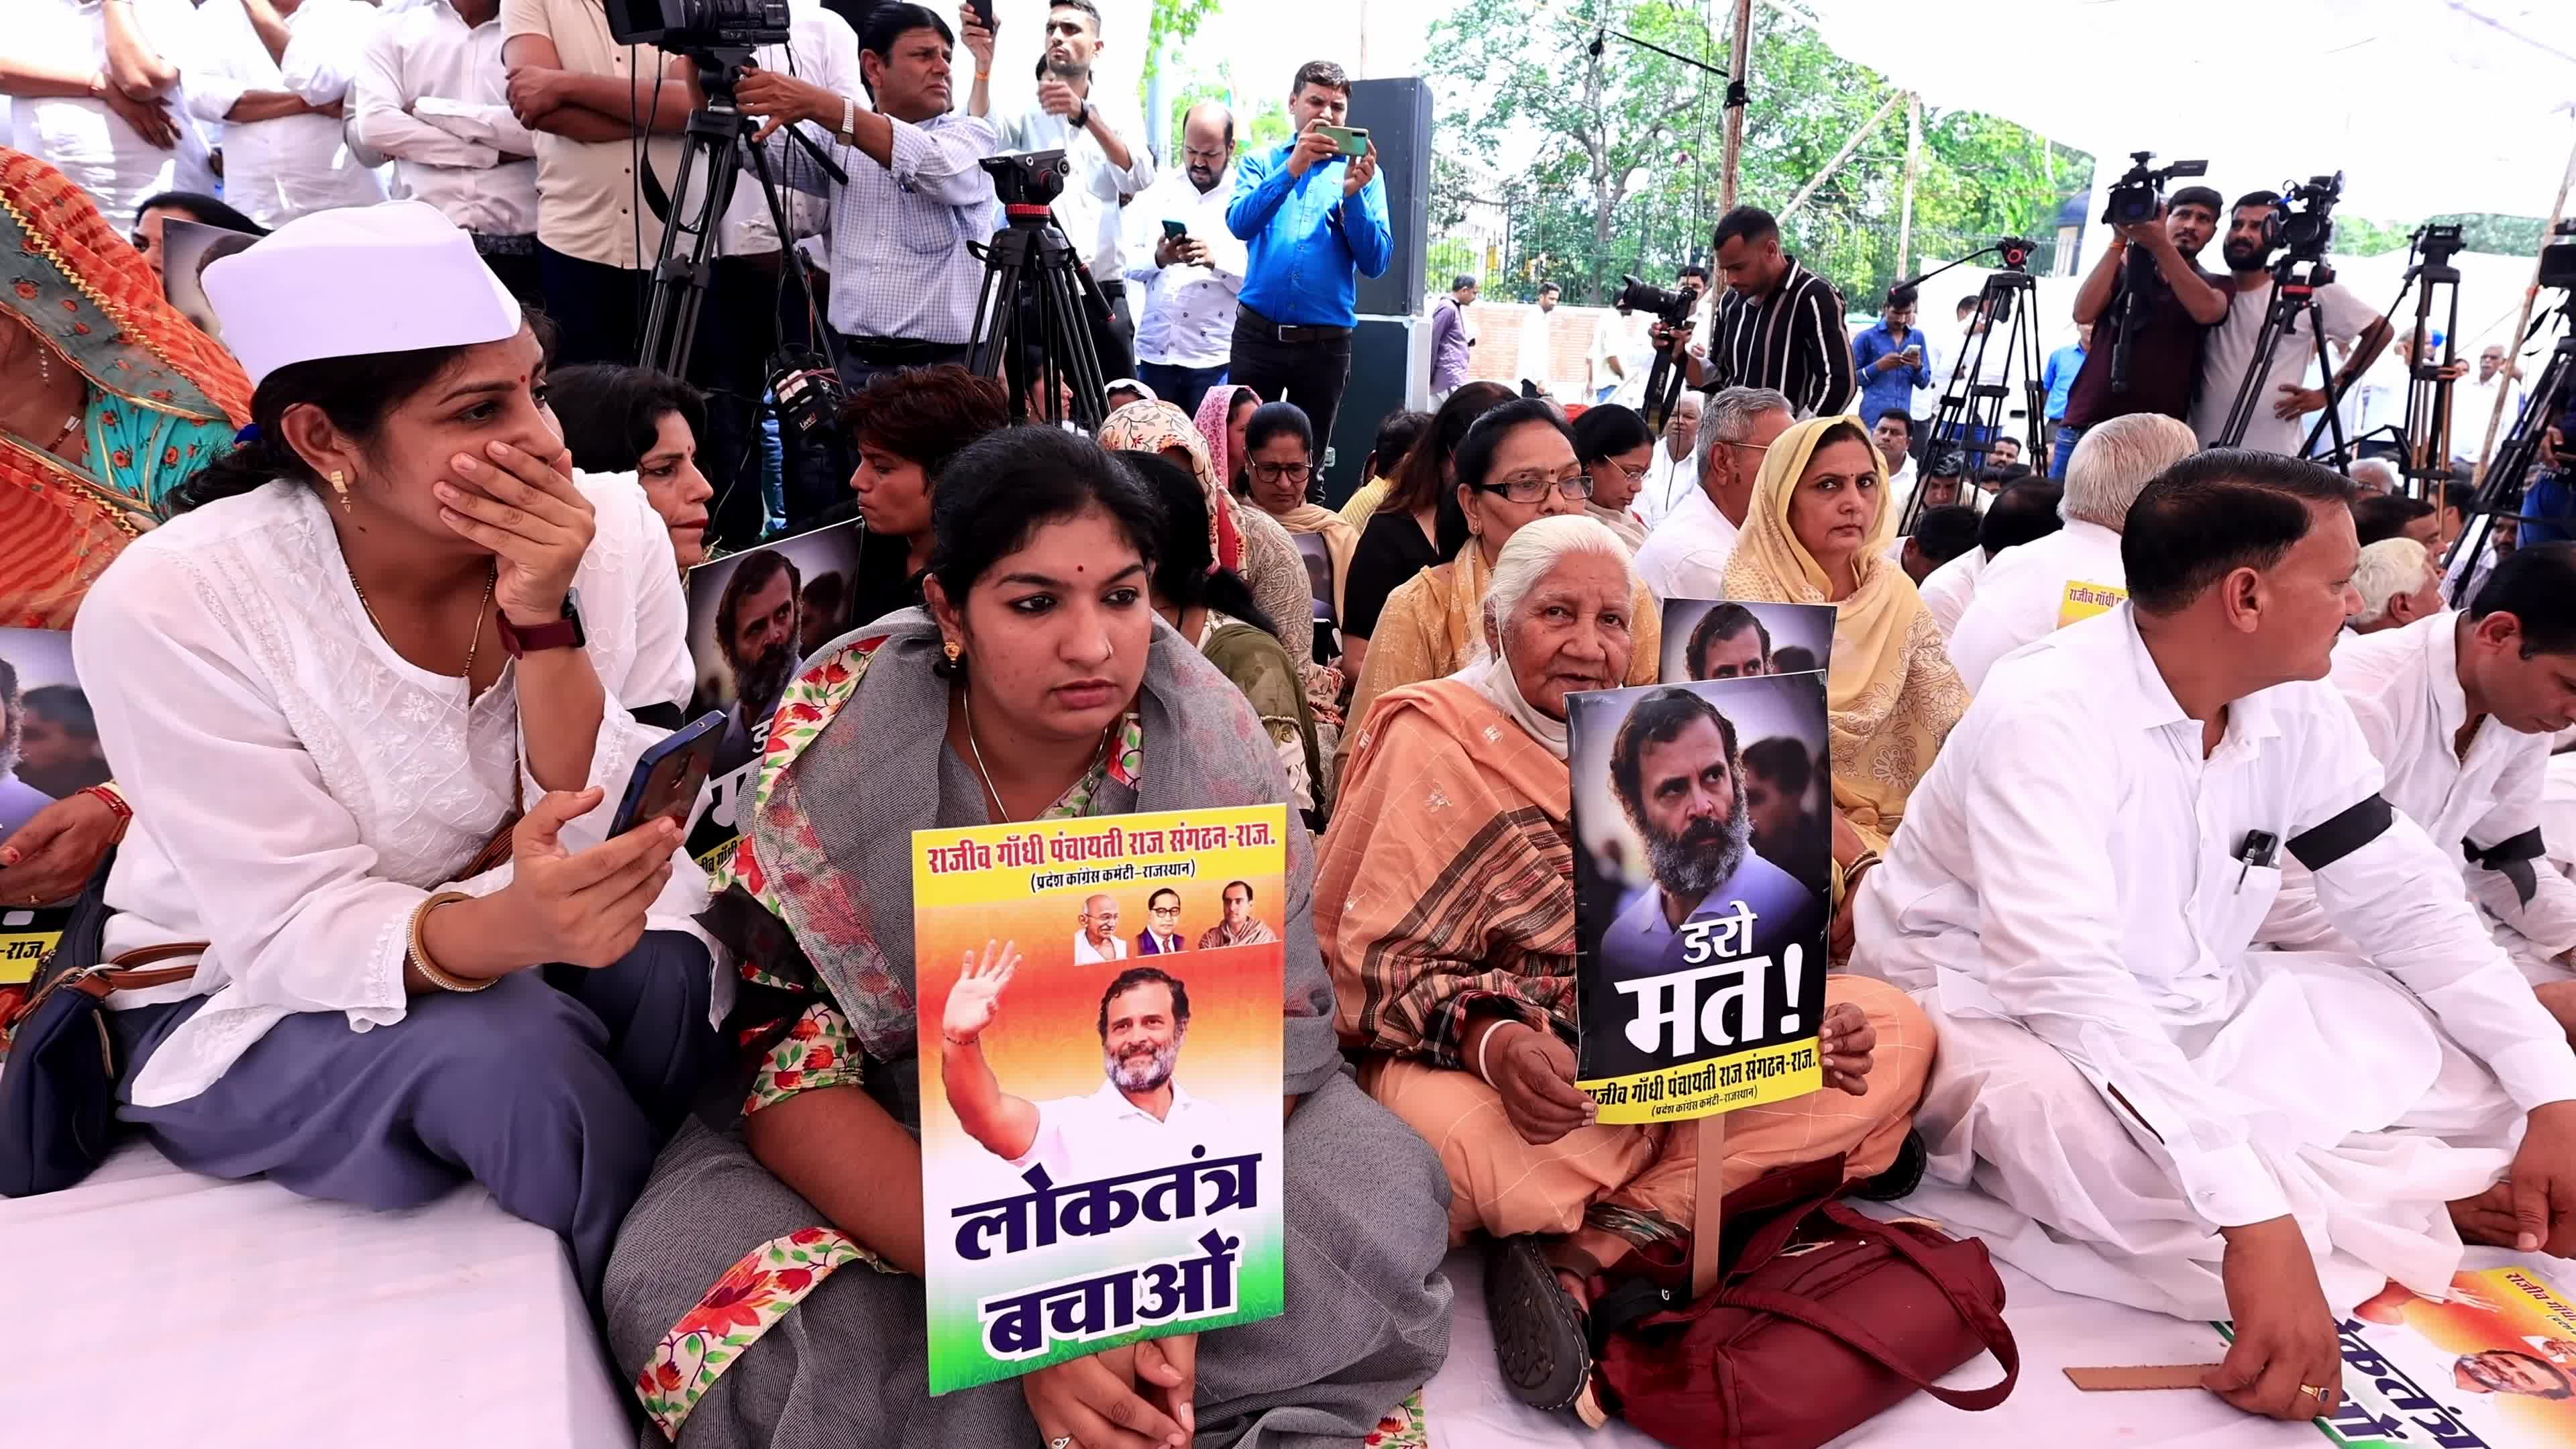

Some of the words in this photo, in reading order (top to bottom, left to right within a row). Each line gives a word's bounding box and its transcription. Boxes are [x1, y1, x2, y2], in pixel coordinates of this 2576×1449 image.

[928, 839, 992, 873] राजीव
[1050, 827, 1124, 862] पंचायती
[1128, 830, 1163, 855] राज
[1679, 900, 1758, 964] डरो
[1668, 1063, 1716, 1097] पंचायती
[1719, 1063, 1742, 1087] राज
[951, 1144, 1263, 1260] लोकतंत्र
[985, 1228, 1240, 1354] बचाओं
